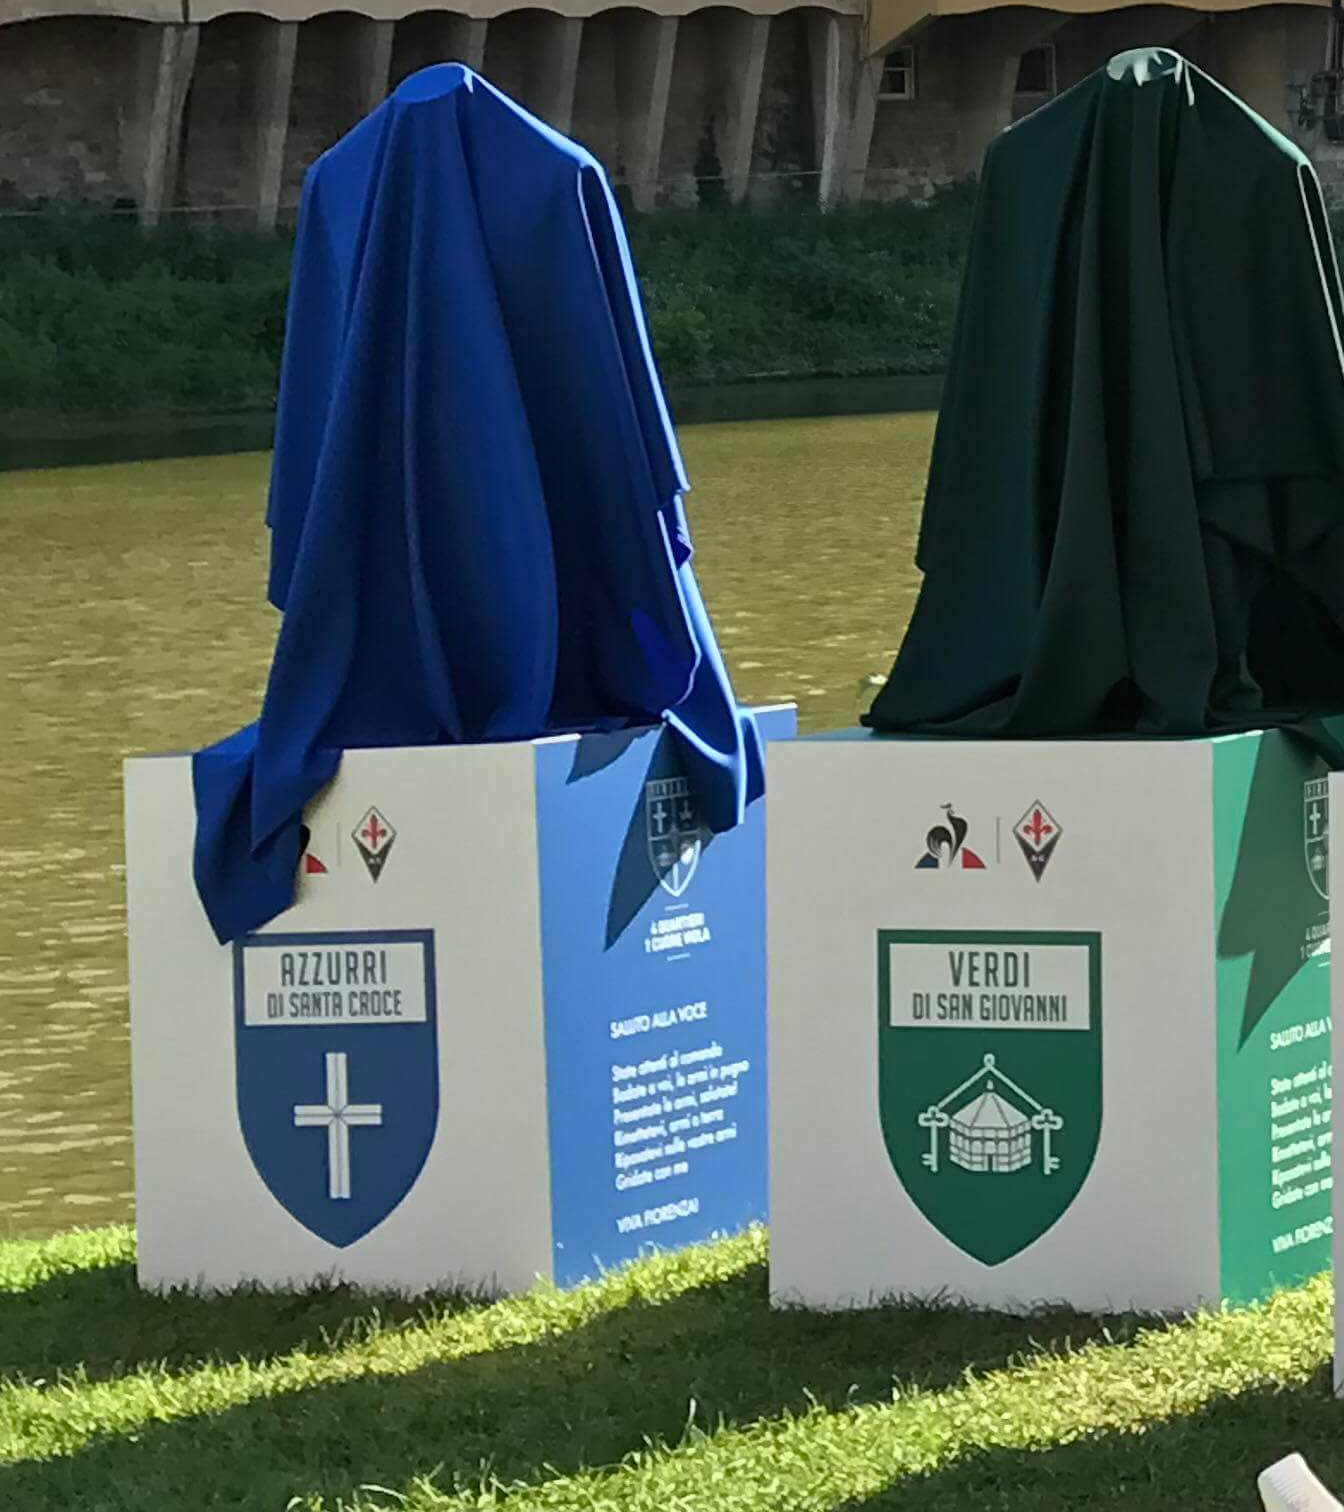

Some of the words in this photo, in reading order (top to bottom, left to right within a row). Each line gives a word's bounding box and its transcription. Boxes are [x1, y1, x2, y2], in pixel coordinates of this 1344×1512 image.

[281, 950, 387, 987] AZZURRI
[949, 951, 1030, 988] VERDI
[267, 992, 285, 1019] DI
[289, 991, 344, 1018] SANTA
[348, 989, 403, 1016] CROCE
[912, 992, 931, 1020] DI
[936, 992, 973, 1020] SAN
[979, 993, 1068, 1022] GIOVANNI
